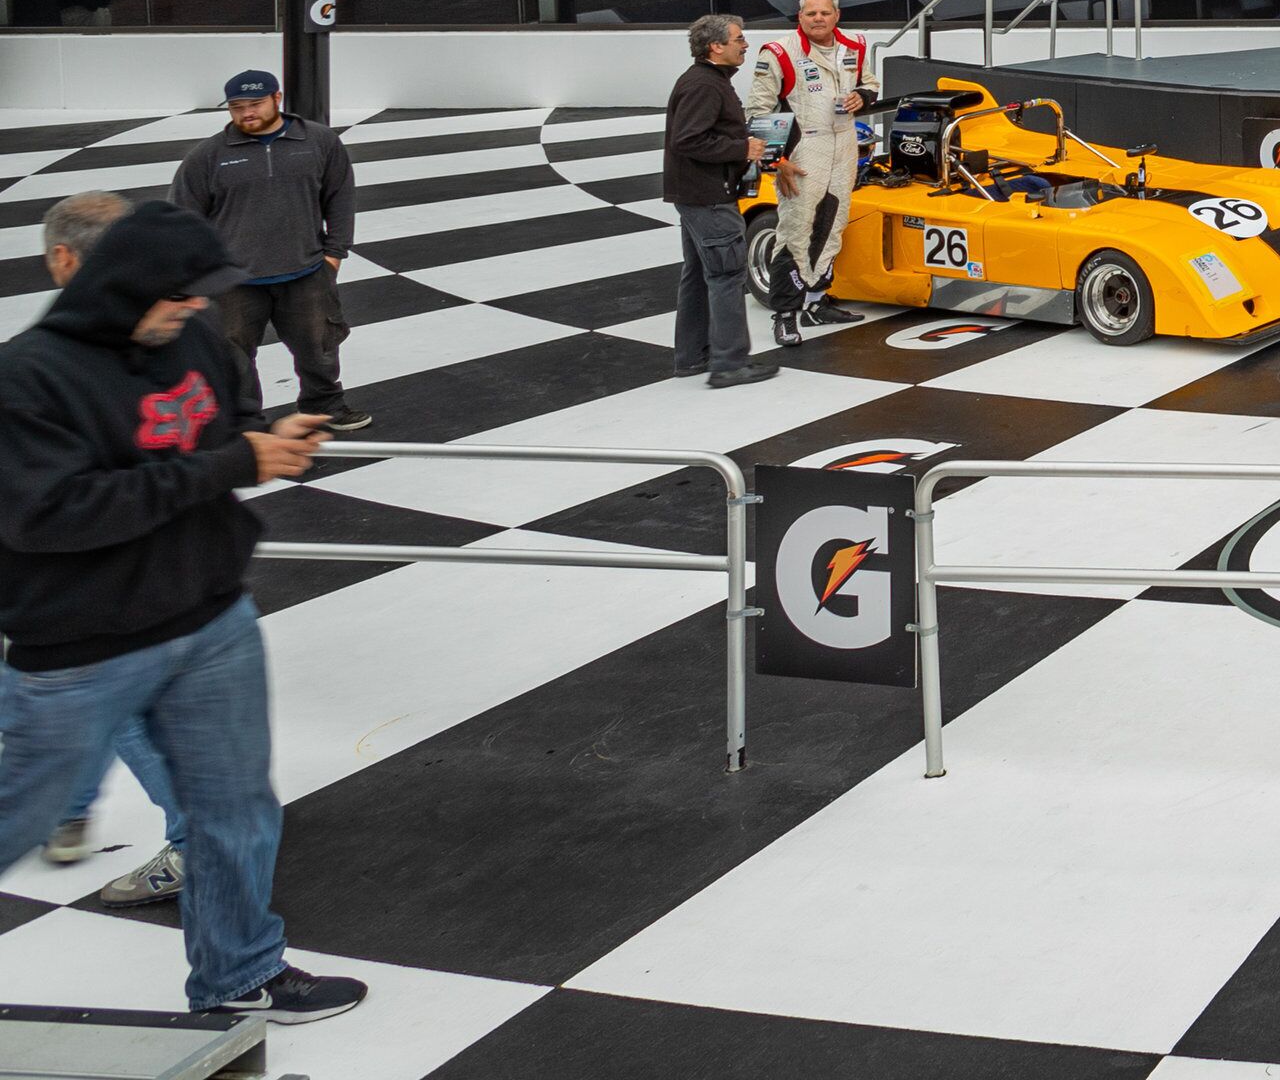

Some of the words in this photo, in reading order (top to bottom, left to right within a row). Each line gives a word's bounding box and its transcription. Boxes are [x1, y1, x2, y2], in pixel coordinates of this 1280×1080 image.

[1192, 199, 1263, 230] 26
[925, 228, 968, 267] 26
[886, 319, 1006, 350] G
[775, 505, 892, 650] G
